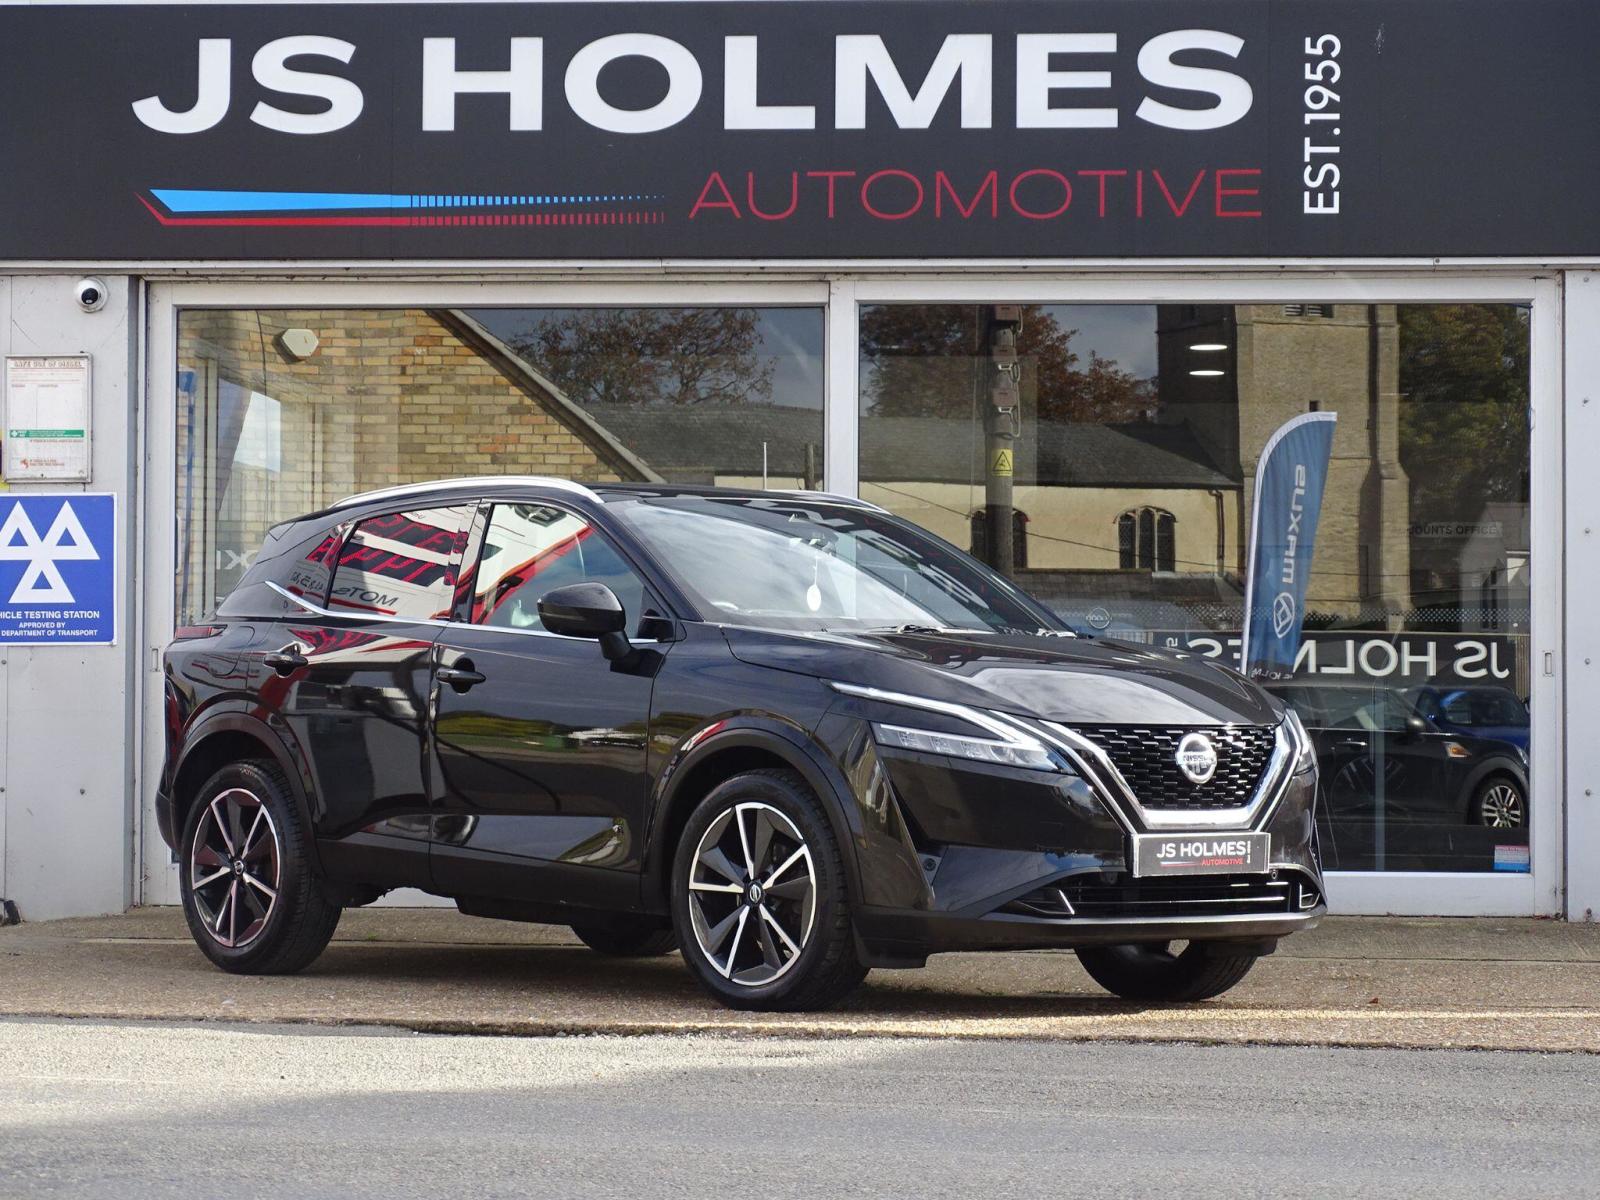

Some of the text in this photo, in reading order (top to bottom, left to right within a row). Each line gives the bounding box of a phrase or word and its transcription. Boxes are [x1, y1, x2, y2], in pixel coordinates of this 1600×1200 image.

[131, 29, 1254, 135] JS HOLMES
[1303, 32, 1342, 215] EST.1955
[688, 167, 1263, 221] AUTOMOTIVE
[24, 611, 61, 619] TESTING
[63, 610, 100, 619] STATION
[1156, 843, 1176, 858] JS
[1180, 841, 1247, 857] HOLMES
[1201, 858, 1244, 866] AUTOMOTIVE
